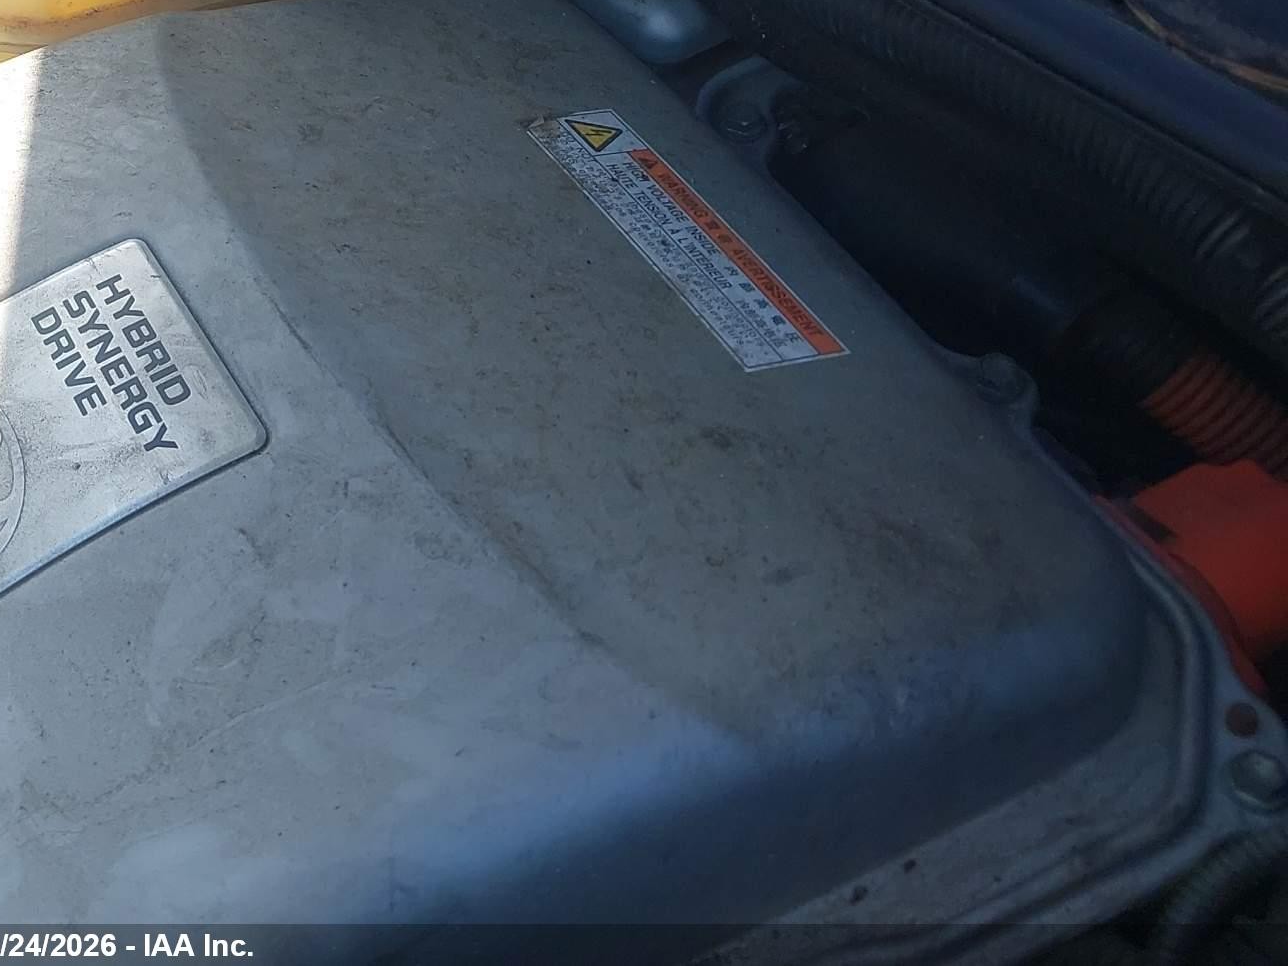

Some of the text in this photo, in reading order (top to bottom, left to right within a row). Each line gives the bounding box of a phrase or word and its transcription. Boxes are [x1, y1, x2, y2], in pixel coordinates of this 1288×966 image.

[606, 163, 637, 189] HAUTE
[633, 190, 673, 226] TENSION
[622, 161, 650, 183] HIGH
[646, 184, 689, 222] VOLTAGE
[684, 225, 720, 255] INSIDE
[657, 172, 709, 218] WARNING
[97, 274, 191, 405] HYBRID
[730, 248, 824, 337] AVERTISSEMENT
[32, 307, 107, 416] DRIVE
[63, 290, 178, 451] SYNERGY
